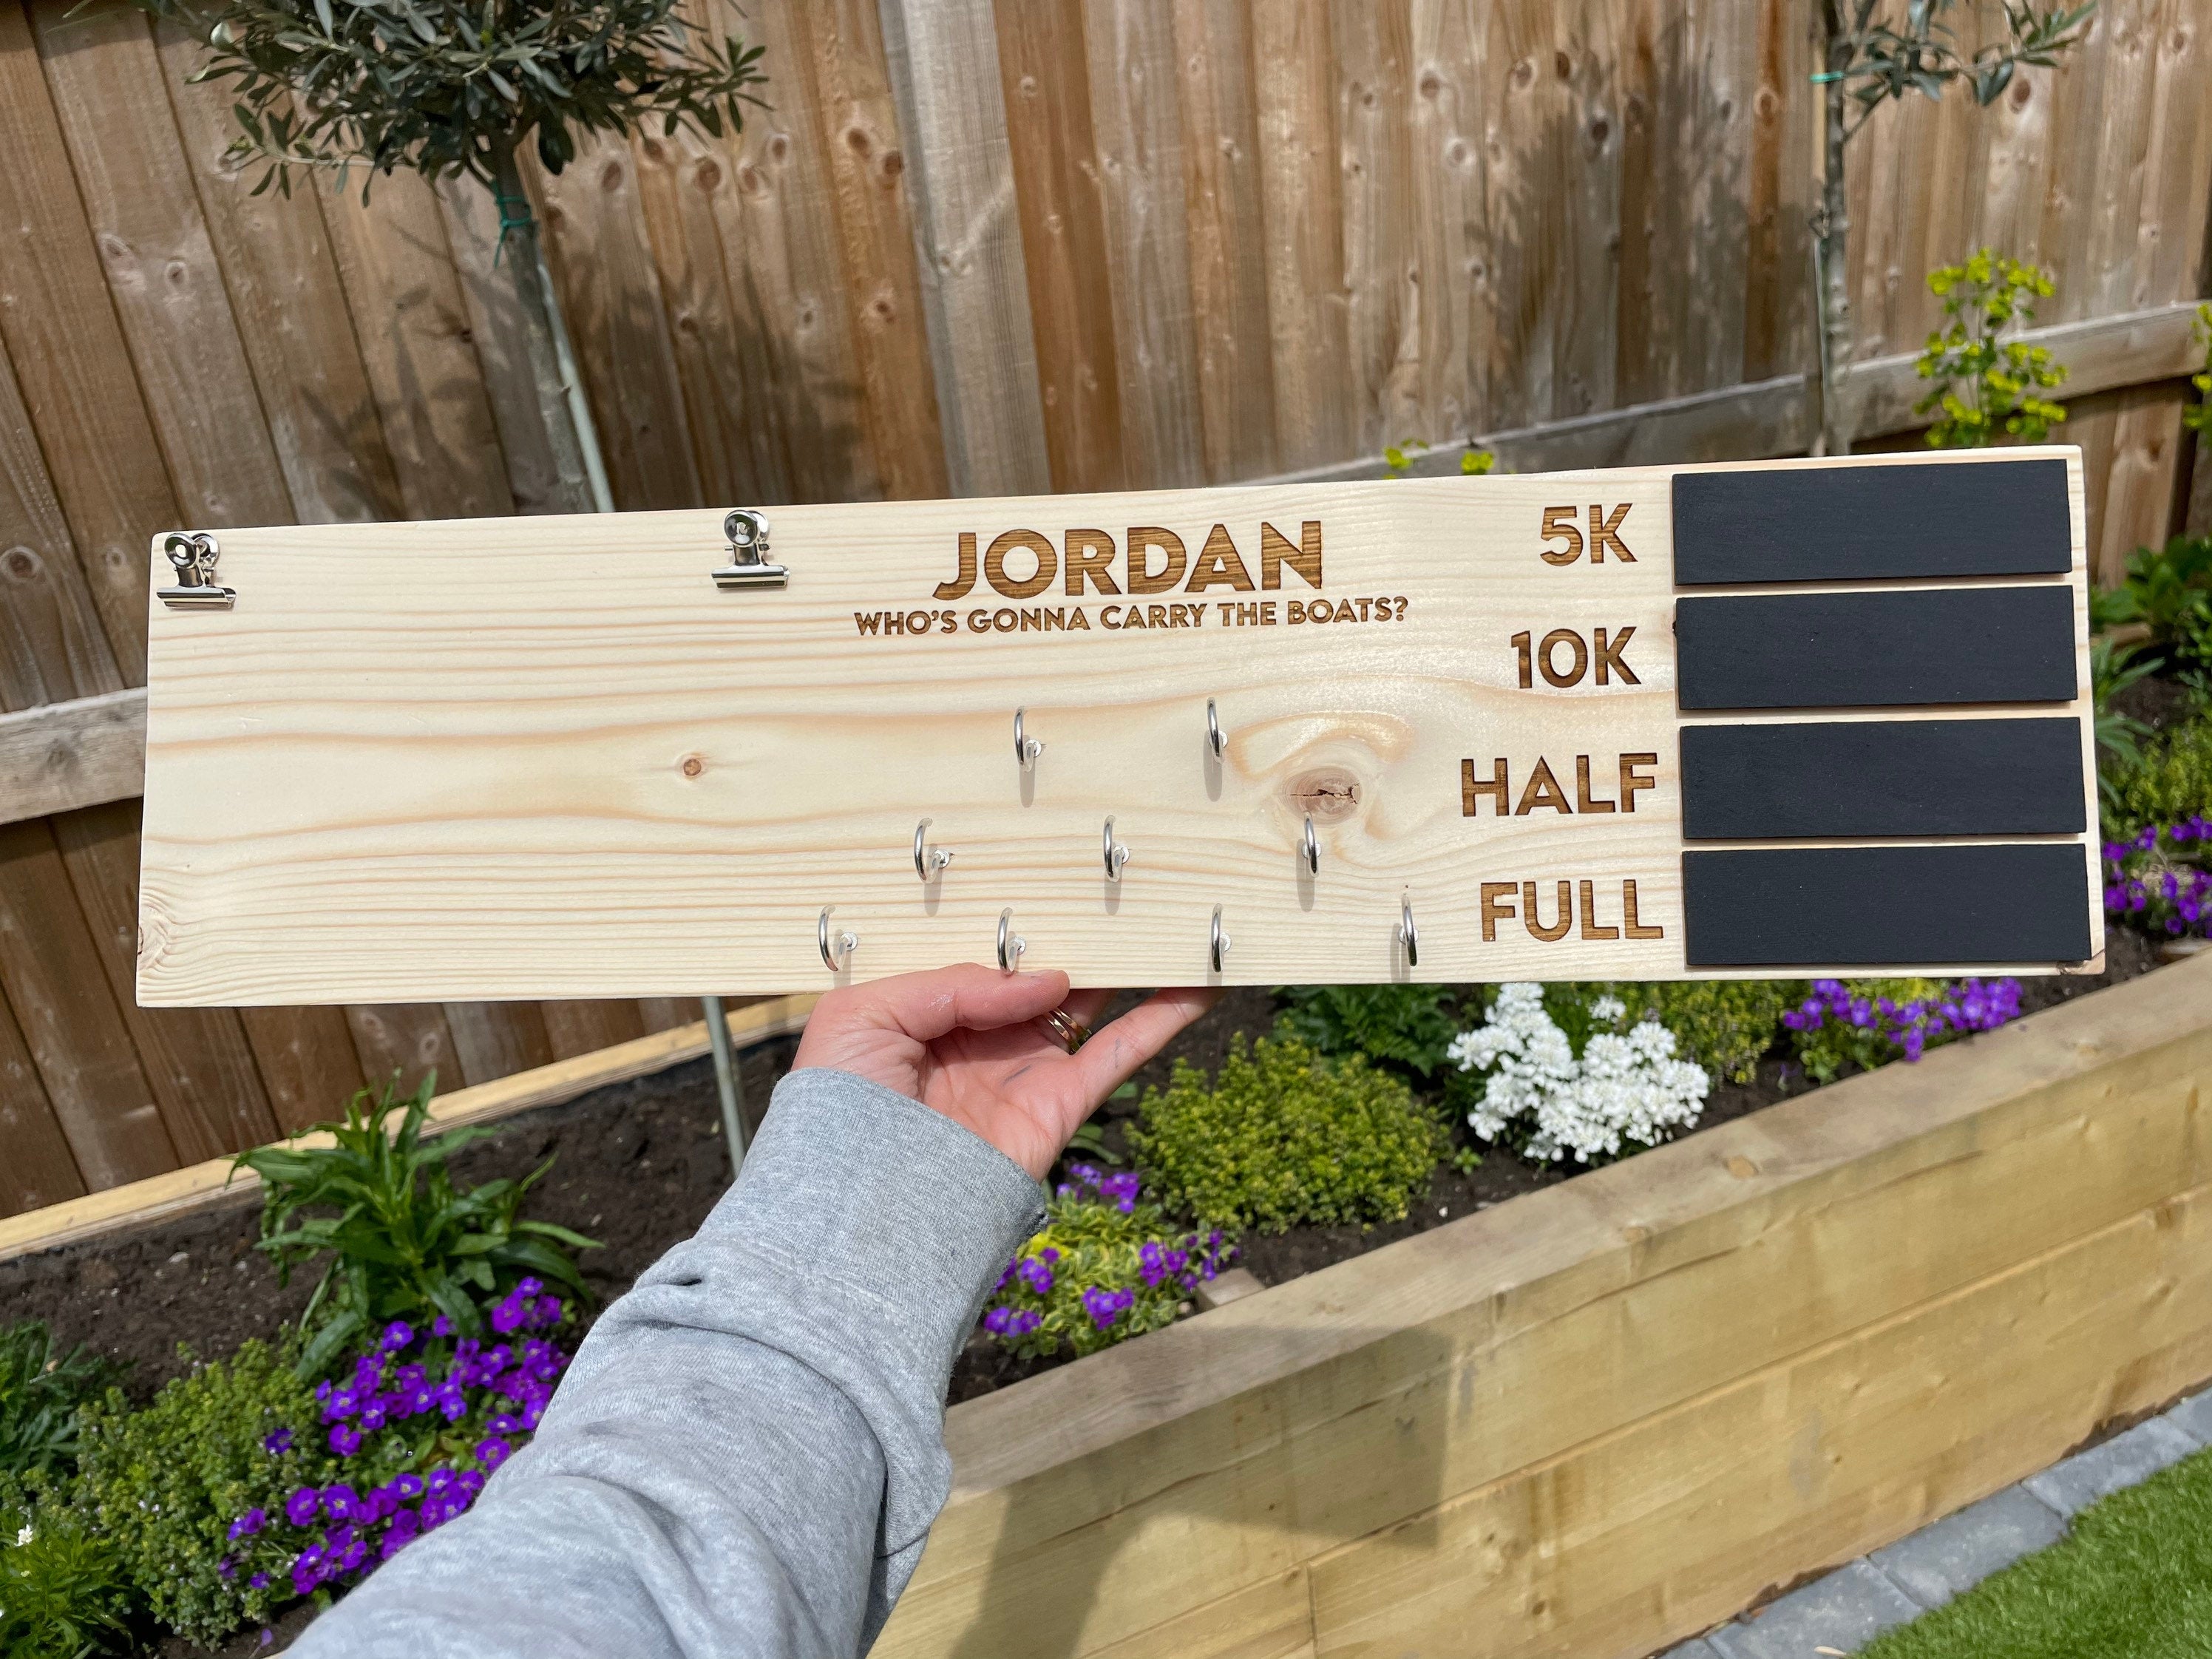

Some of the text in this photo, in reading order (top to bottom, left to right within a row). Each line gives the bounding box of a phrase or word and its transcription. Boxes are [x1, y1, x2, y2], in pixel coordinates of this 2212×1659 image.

[932, 520, 1323, 601] JORDAN
[1539, 503, 1638, 567] 5K
[853, 596, 1408, 637] WHO'S GONNA CARRY THE BOATS?
[1510, 626, 1642, 690] 10K
[1461, 752, 1658, 818] HALF
[1480, 878, 1664, 943] FULL
